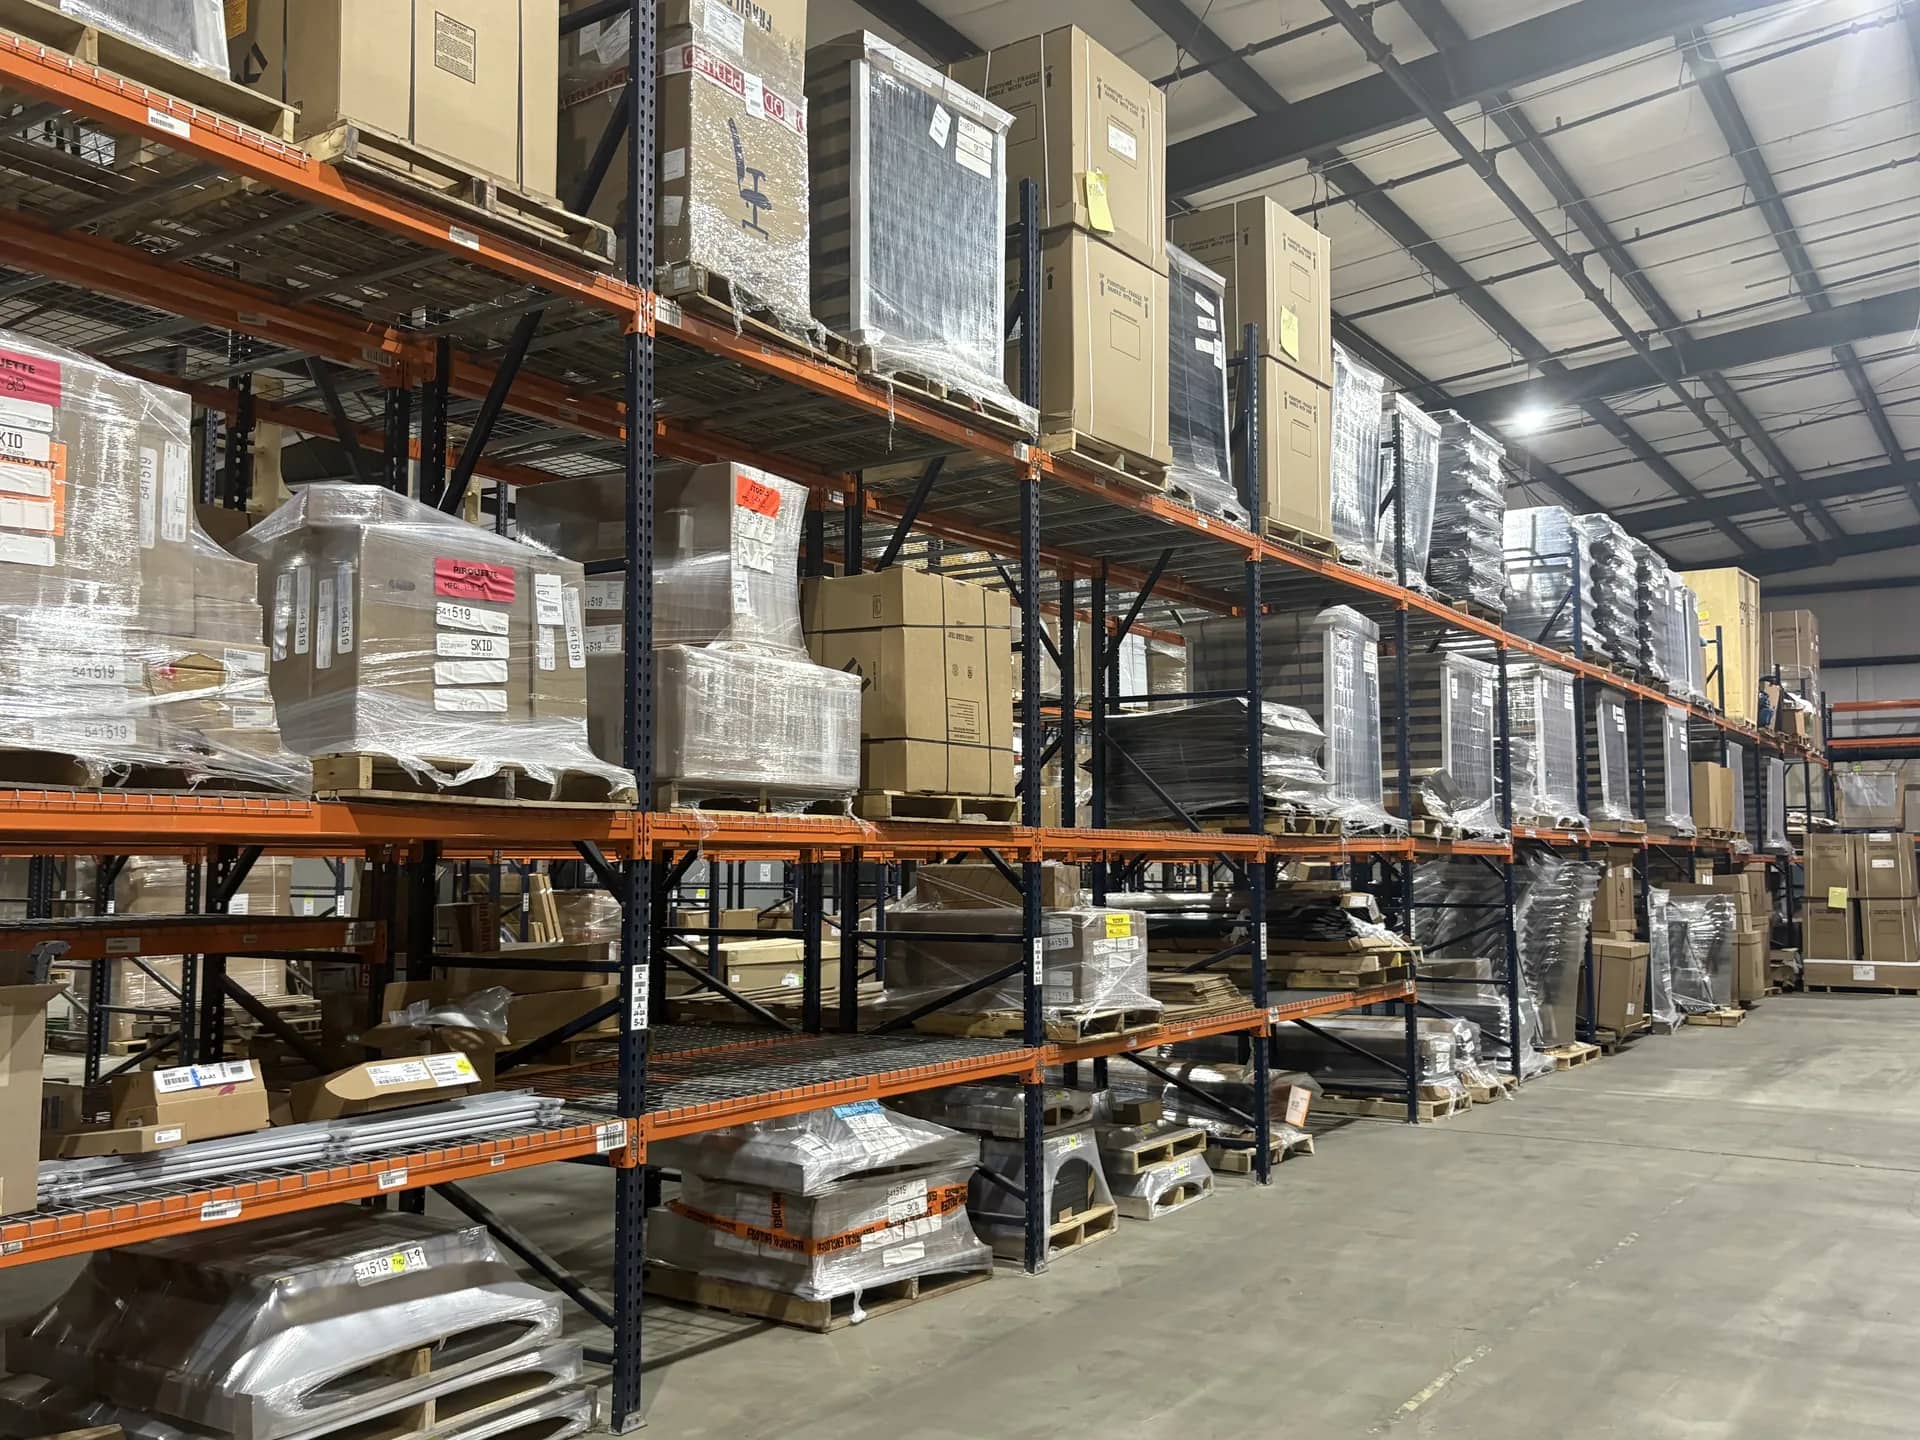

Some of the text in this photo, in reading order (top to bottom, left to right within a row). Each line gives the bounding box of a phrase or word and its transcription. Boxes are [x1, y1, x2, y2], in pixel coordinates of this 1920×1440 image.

[436, 606, 471, 620] 541519
[470, 638, 493, 652] SKID
[72, 664, 115, 679] 541519
[84, 724, 127, 740] 541519
[355, 1258, 389, 1279] 541519
